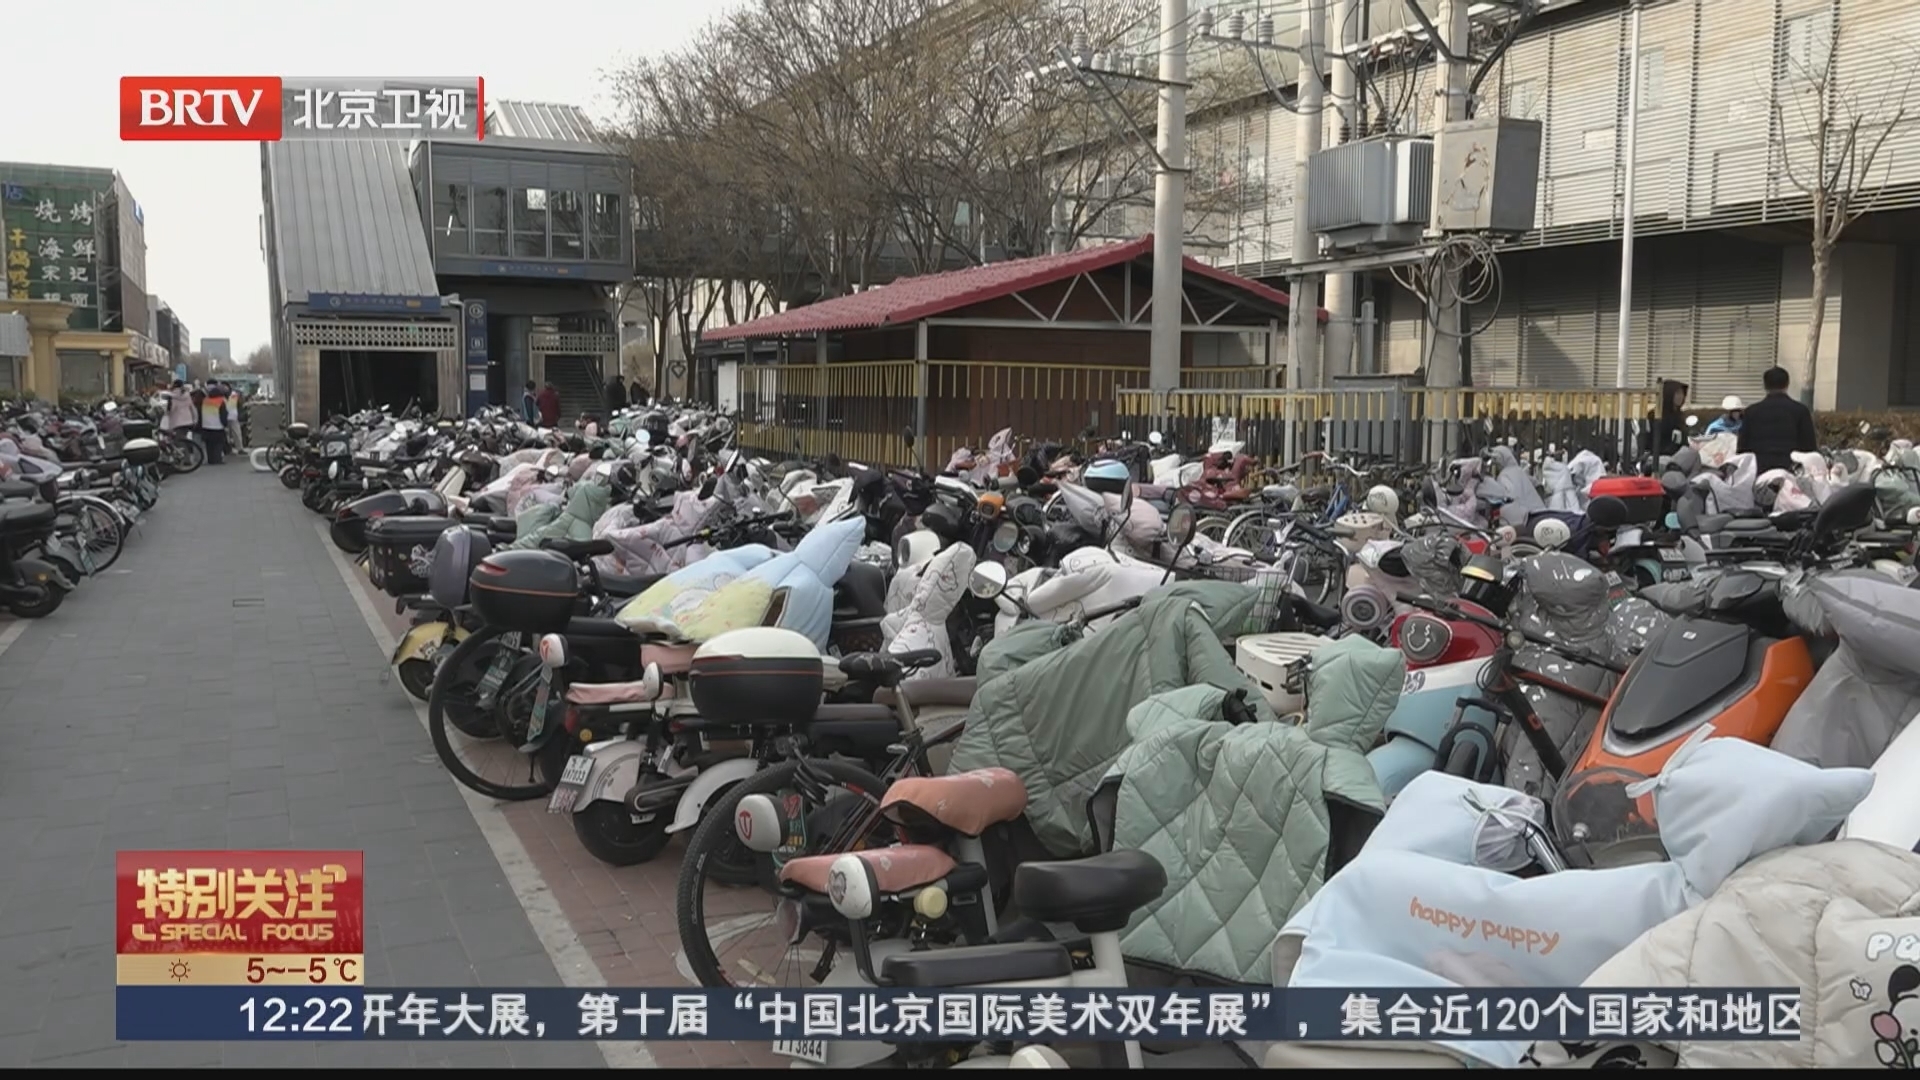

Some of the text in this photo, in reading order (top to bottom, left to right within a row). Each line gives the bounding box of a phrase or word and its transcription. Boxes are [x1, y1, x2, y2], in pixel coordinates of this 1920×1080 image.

[34, 198, 94, 226] 烧烤
[38, 236, 96, 263] 海鲜
[1410, 896, 1560, 955] happy puppy
